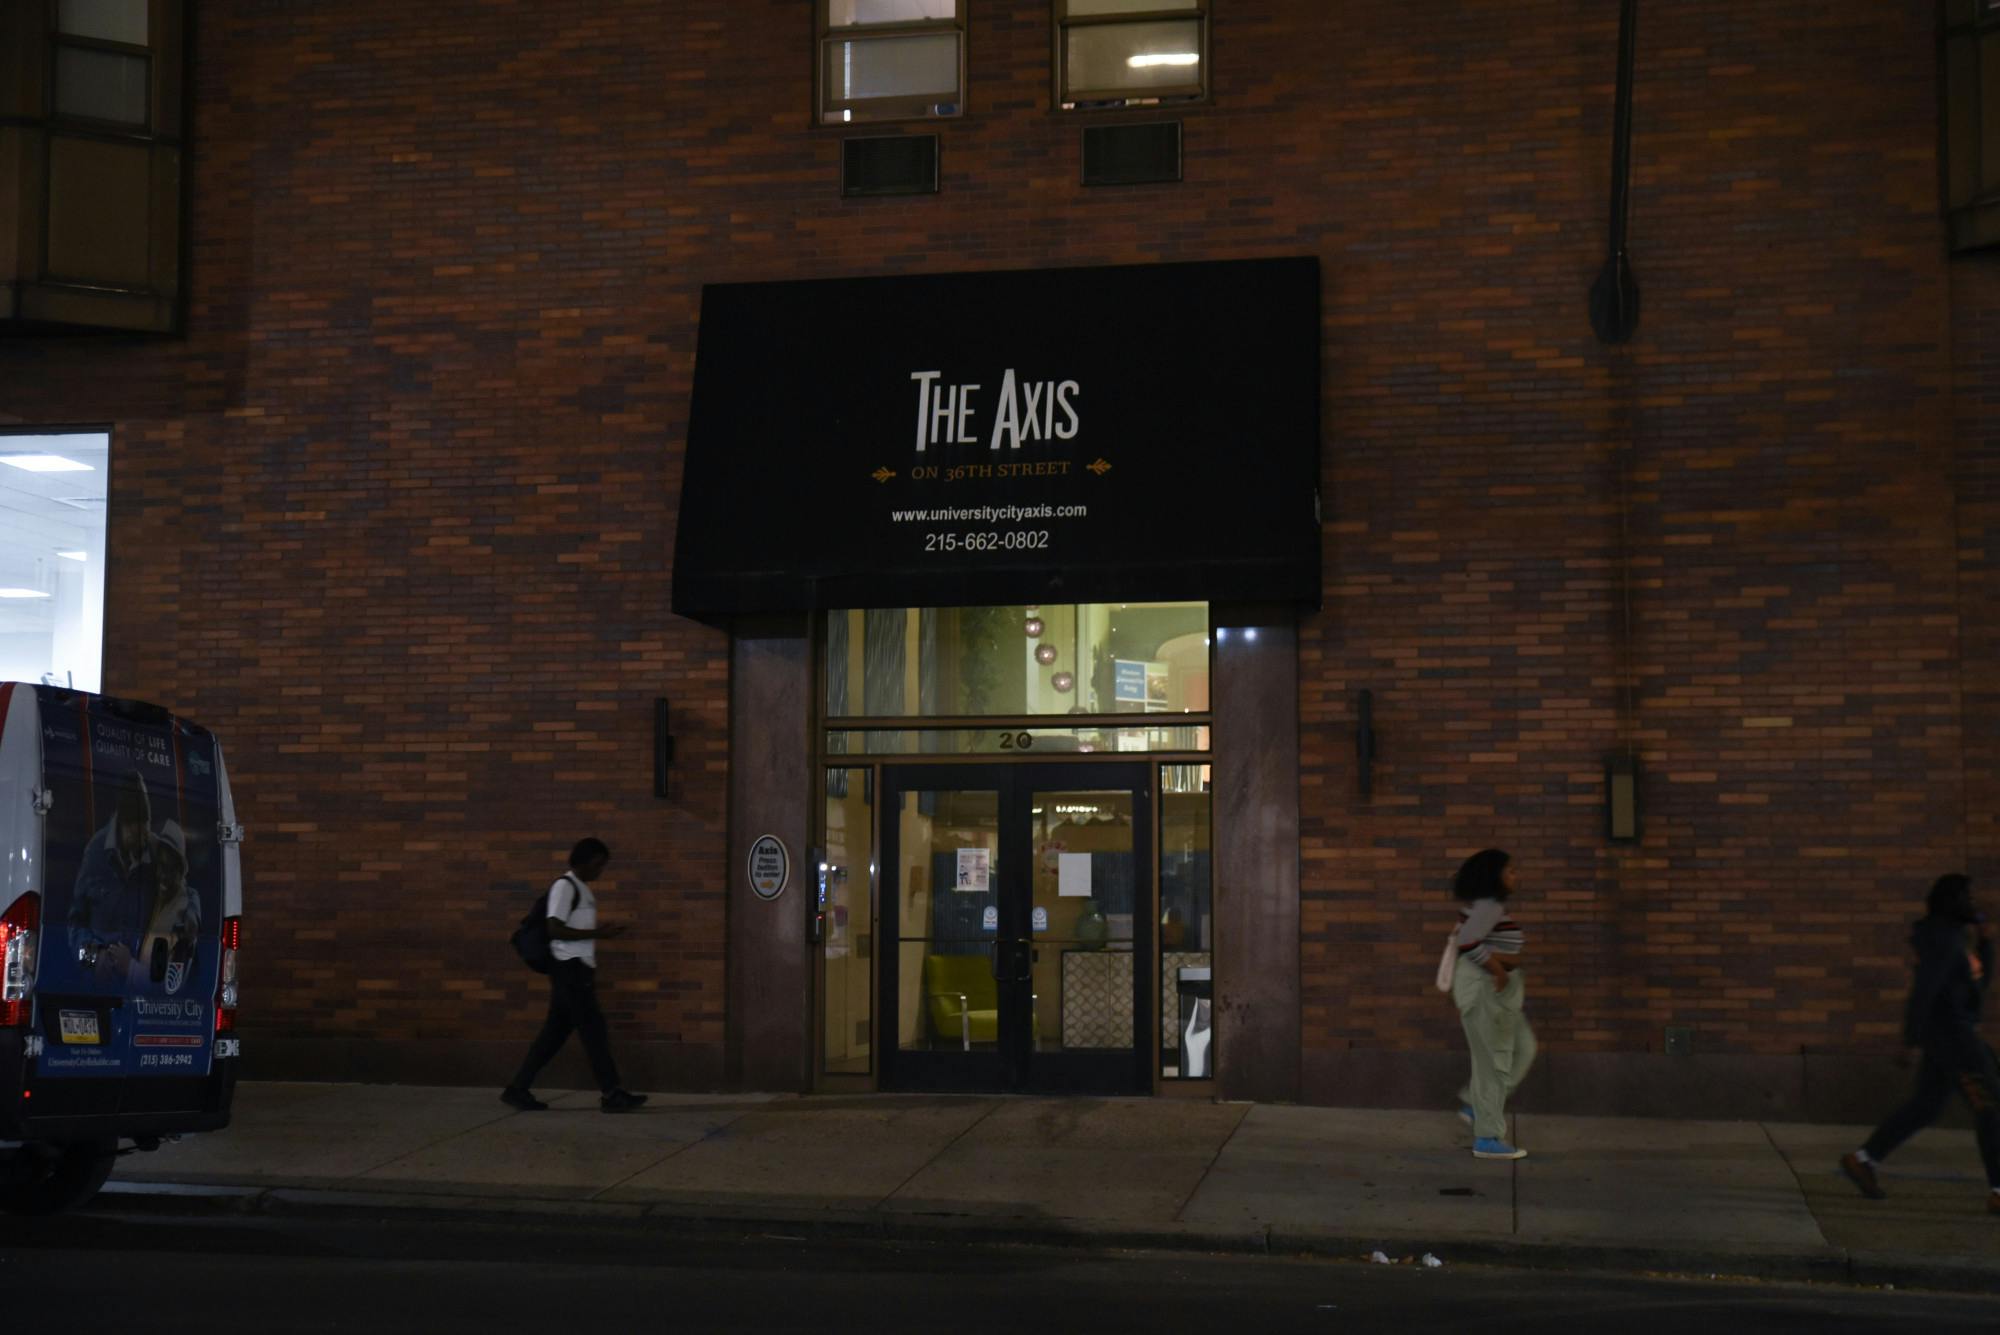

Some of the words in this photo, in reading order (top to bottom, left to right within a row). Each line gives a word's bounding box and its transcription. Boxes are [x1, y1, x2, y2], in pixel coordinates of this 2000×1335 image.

[911, 465, 938, 480] ON
[944, 463, 993, 482] 36TH
[996, 460, 1071, 478] STREET
[892, 503, 1087, 523] www.universitycityaxis.com
[924, 530, 1049, 552] 215-662-0802
[96, 722, 130, 744] QUALITY
[148, 735, 166, 751] LIFE
[999, 732, 1032, 749] 20
[147, 751, 171, 767] CARE
[758, 846, 778, 855] Axis
[136, 996, 181, 1019] University
[184, 999, 203, 1020] City
